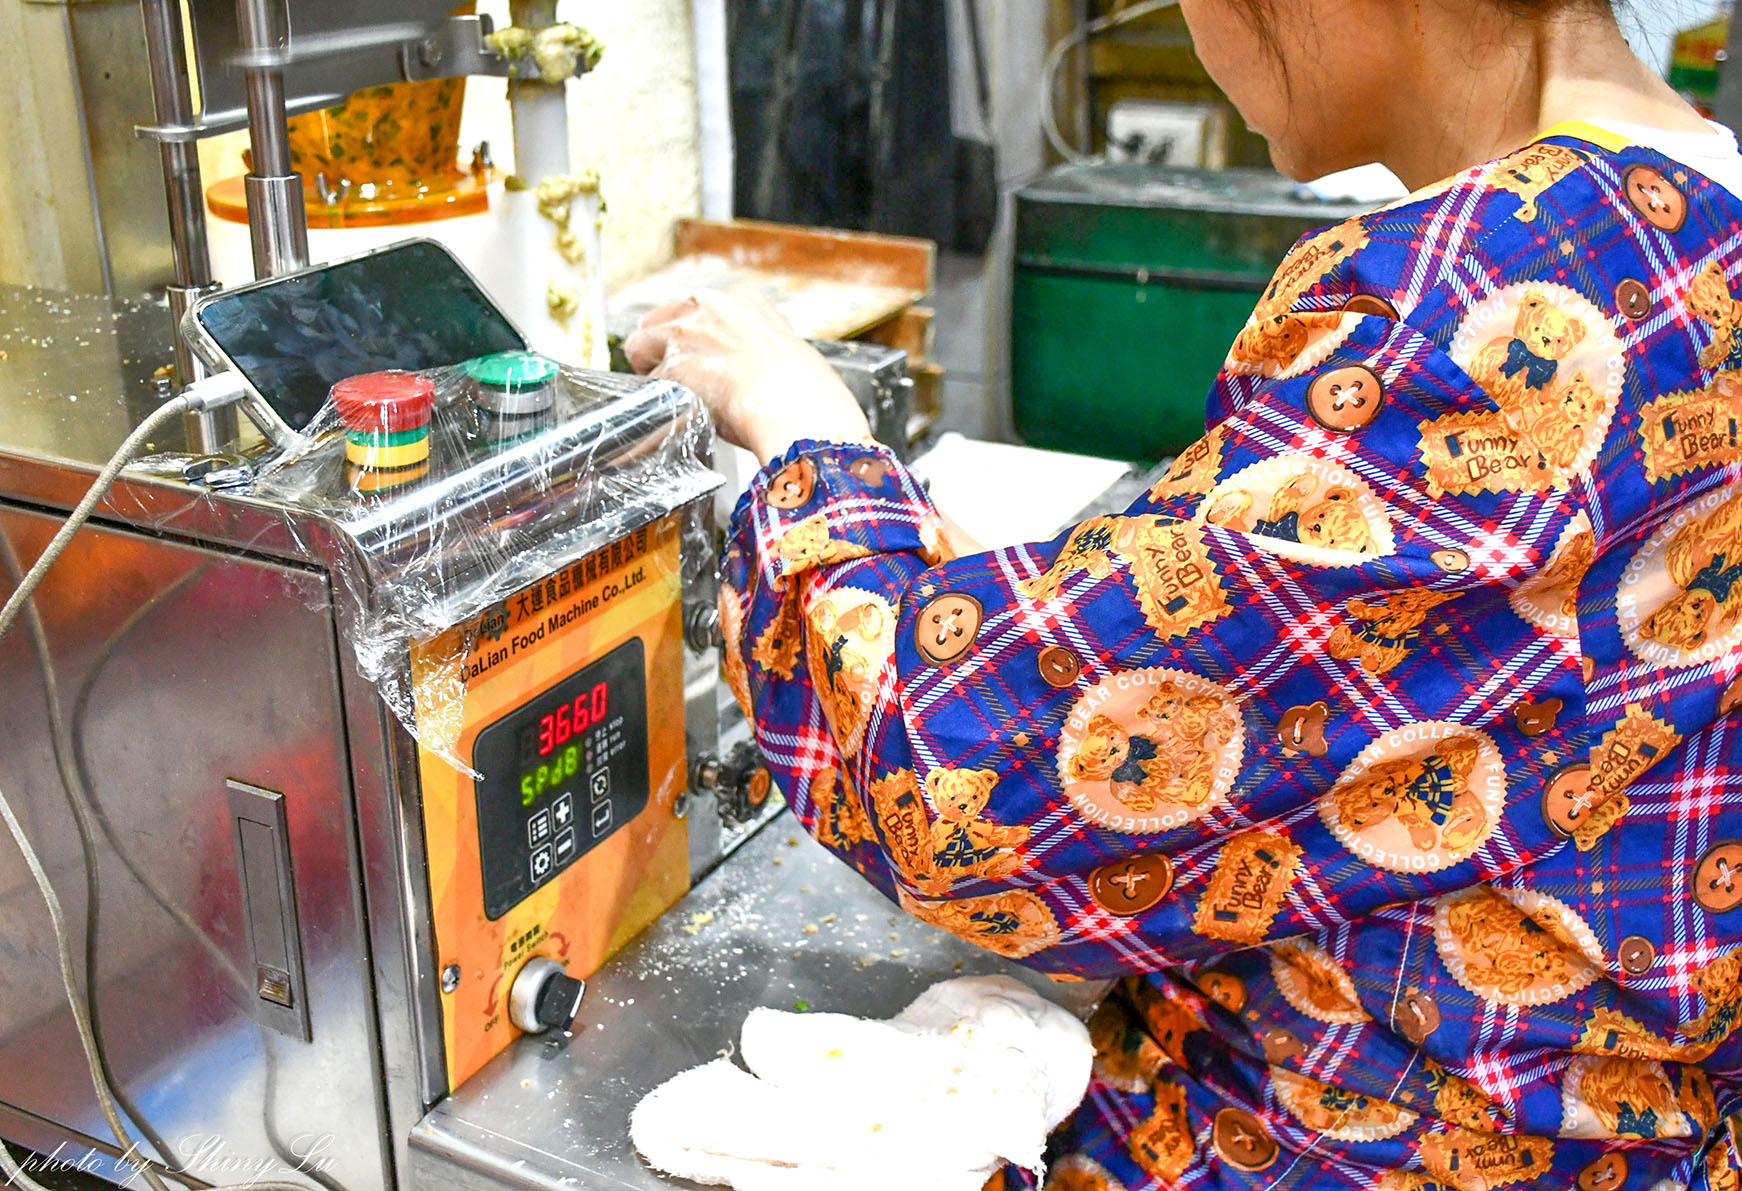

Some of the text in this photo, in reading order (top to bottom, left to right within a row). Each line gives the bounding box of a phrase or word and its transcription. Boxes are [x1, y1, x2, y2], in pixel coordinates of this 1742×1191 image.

[1444, 430, 1518, 459] Funny
[1662, 407, 1714, 441] Funny
[1145, 547, 1190, 616] Funny
[512, 622, 545, 655] Food
[548, 596, 600, 634] Machine
[539, 681, 608, 755] 3660
[1074, 793, 1189, 831] COLLECTION
[1213, 858, 1253, 923] Funny
